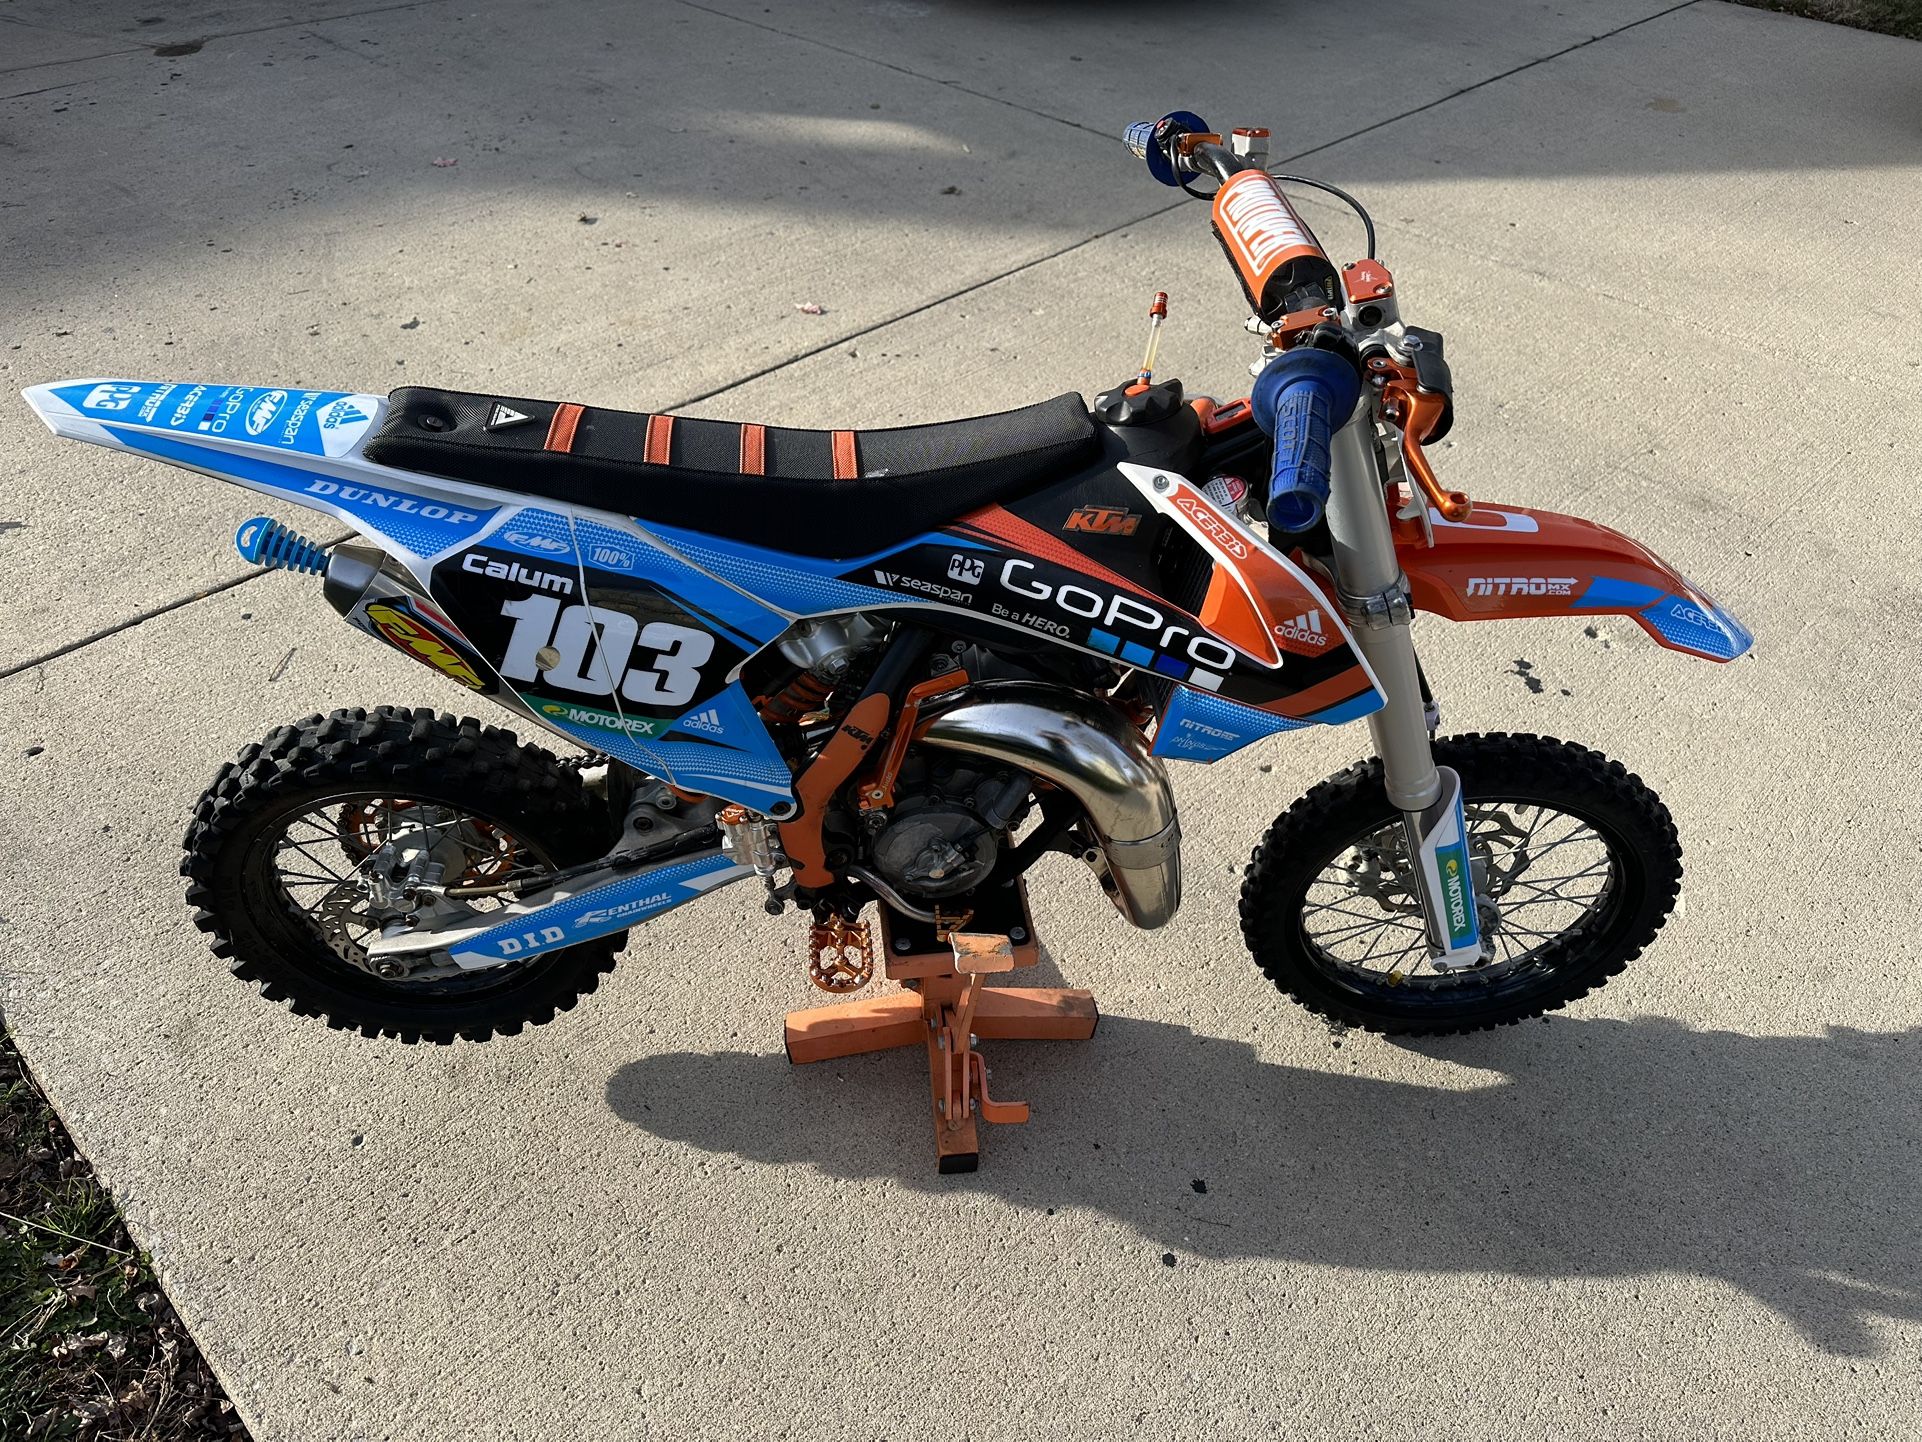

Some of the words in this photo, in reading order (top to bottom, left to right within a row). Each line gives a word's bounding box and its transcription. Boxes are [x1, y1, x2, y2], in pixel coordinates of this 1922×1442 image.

[323, 401, 348, 430] adidas
[304, 479, 478, 526] DUNLOP
[1063, 505, 1141, 536] KTM
[592, 546, 631, 568] 100%
[462, 553, 574, 595] Calum
[900, 576, 973, 605] seaspan
[991, 602, 1009, 618] Be
[1012, 612, 1020, 622] a
[1000, 558, 1236, 671] GoPro
[1274, 625, 1327, 646] adidas
[500, 594, 715, 707] 103
[568, 708, 656, 735] MOTOREX
[682, 718, 725, 735] adidas
[842, 724, 875, 745] KTM
[1447, 875, 1466, 932] MOTOREX
